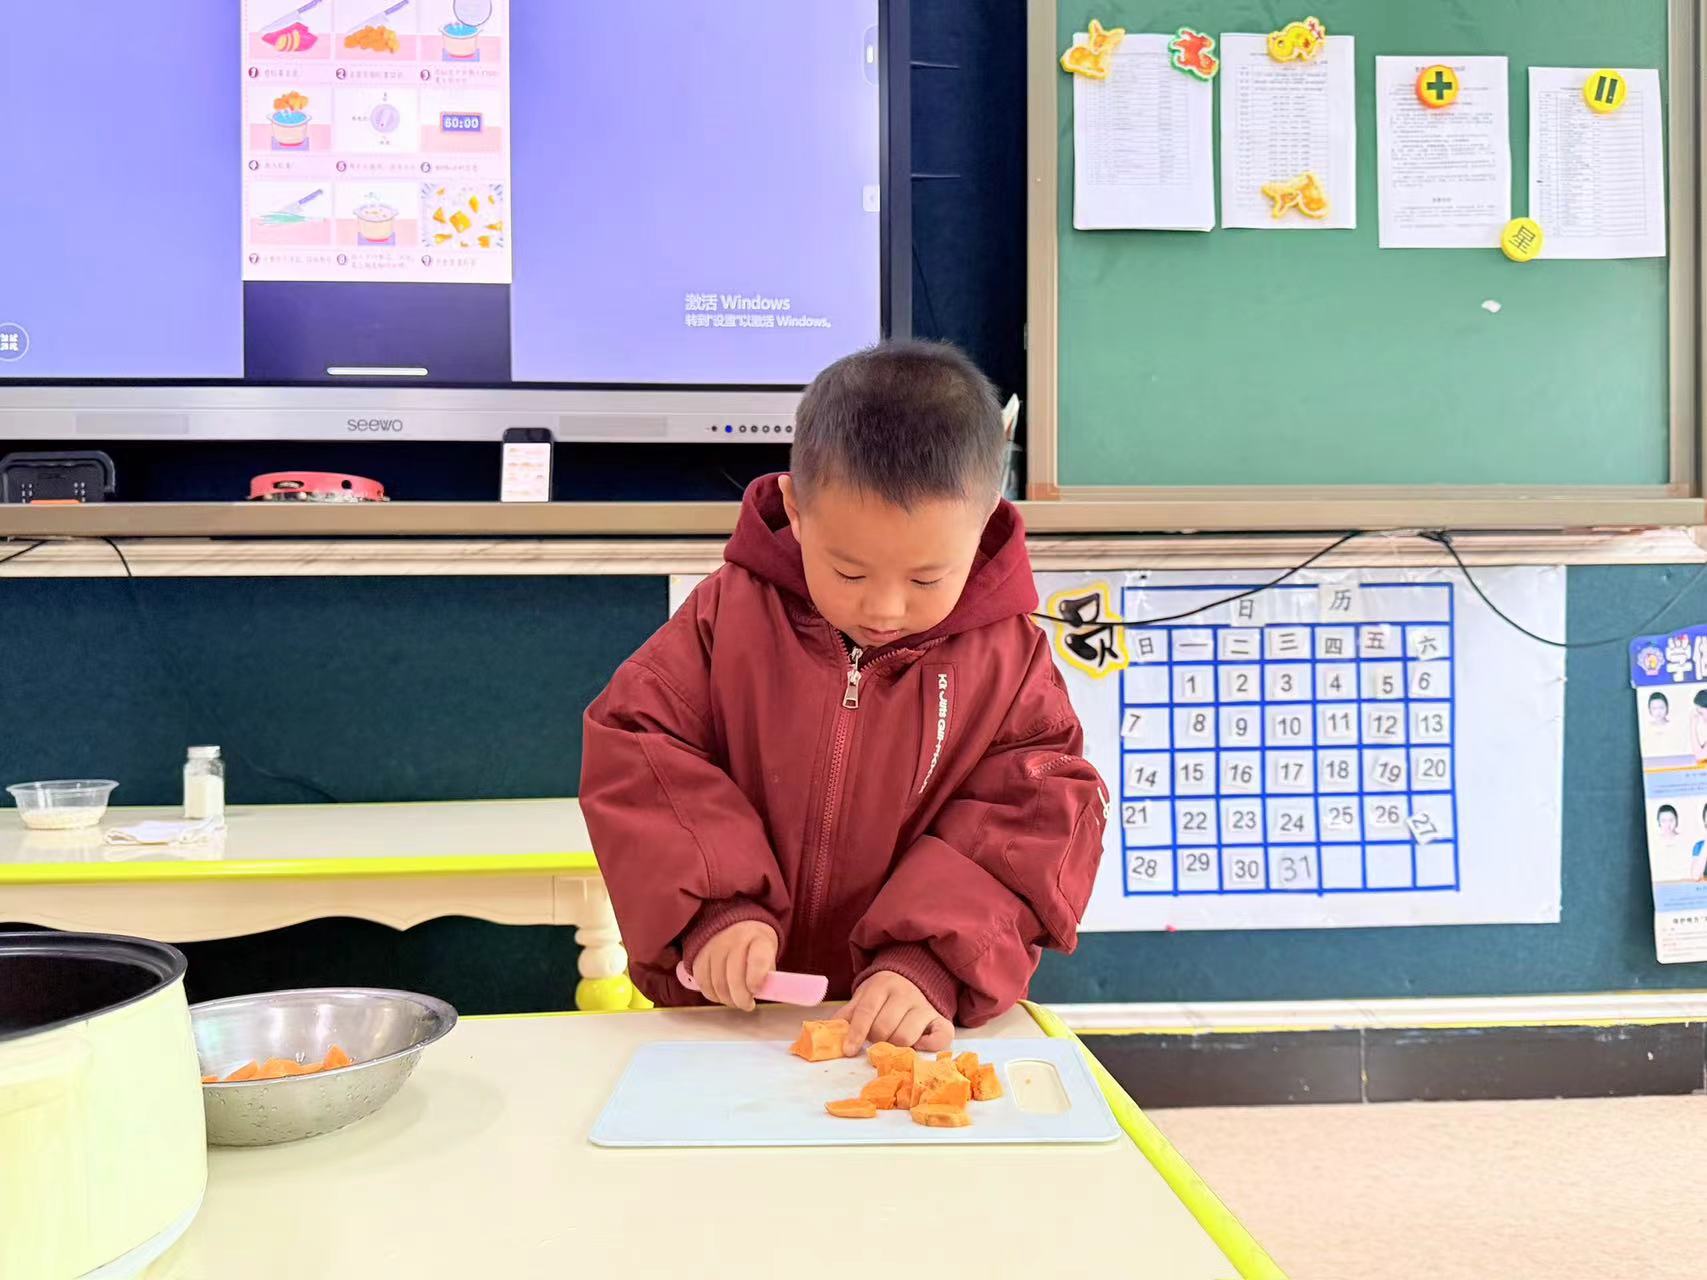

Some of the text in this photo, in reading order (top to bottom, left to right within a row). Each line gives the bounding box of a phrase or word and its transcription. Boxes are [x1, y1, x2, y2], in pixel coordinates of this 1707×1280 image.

[685, 293, 791, 311] 激活 Windows
[347, 418, 403, 432] seewo
[1237, 588, 1353, 620] 日 历
[1138, 637, 1154, 655] 日
[1230, 638, 1251, 656] 二
[1280, 633, 1297, 651] 三
[1325, 638, 1342, 655] 四
[1366, 632, 1385, 650] 五
[1418, 634, 1439, 655] 六
[1187, 671, 1432, 694] 1 2 3 4 5 6
[1126, 712, 1445, 737] 7 8 9 10 11 12 13
[1133, 758, 1447, 788] 14 15 16 17 18 19 20
[1125, 804, 1438, 839] 21 22 23 24 25 26 27
[1132, 853, 1313, 883] 28 29 30 31
